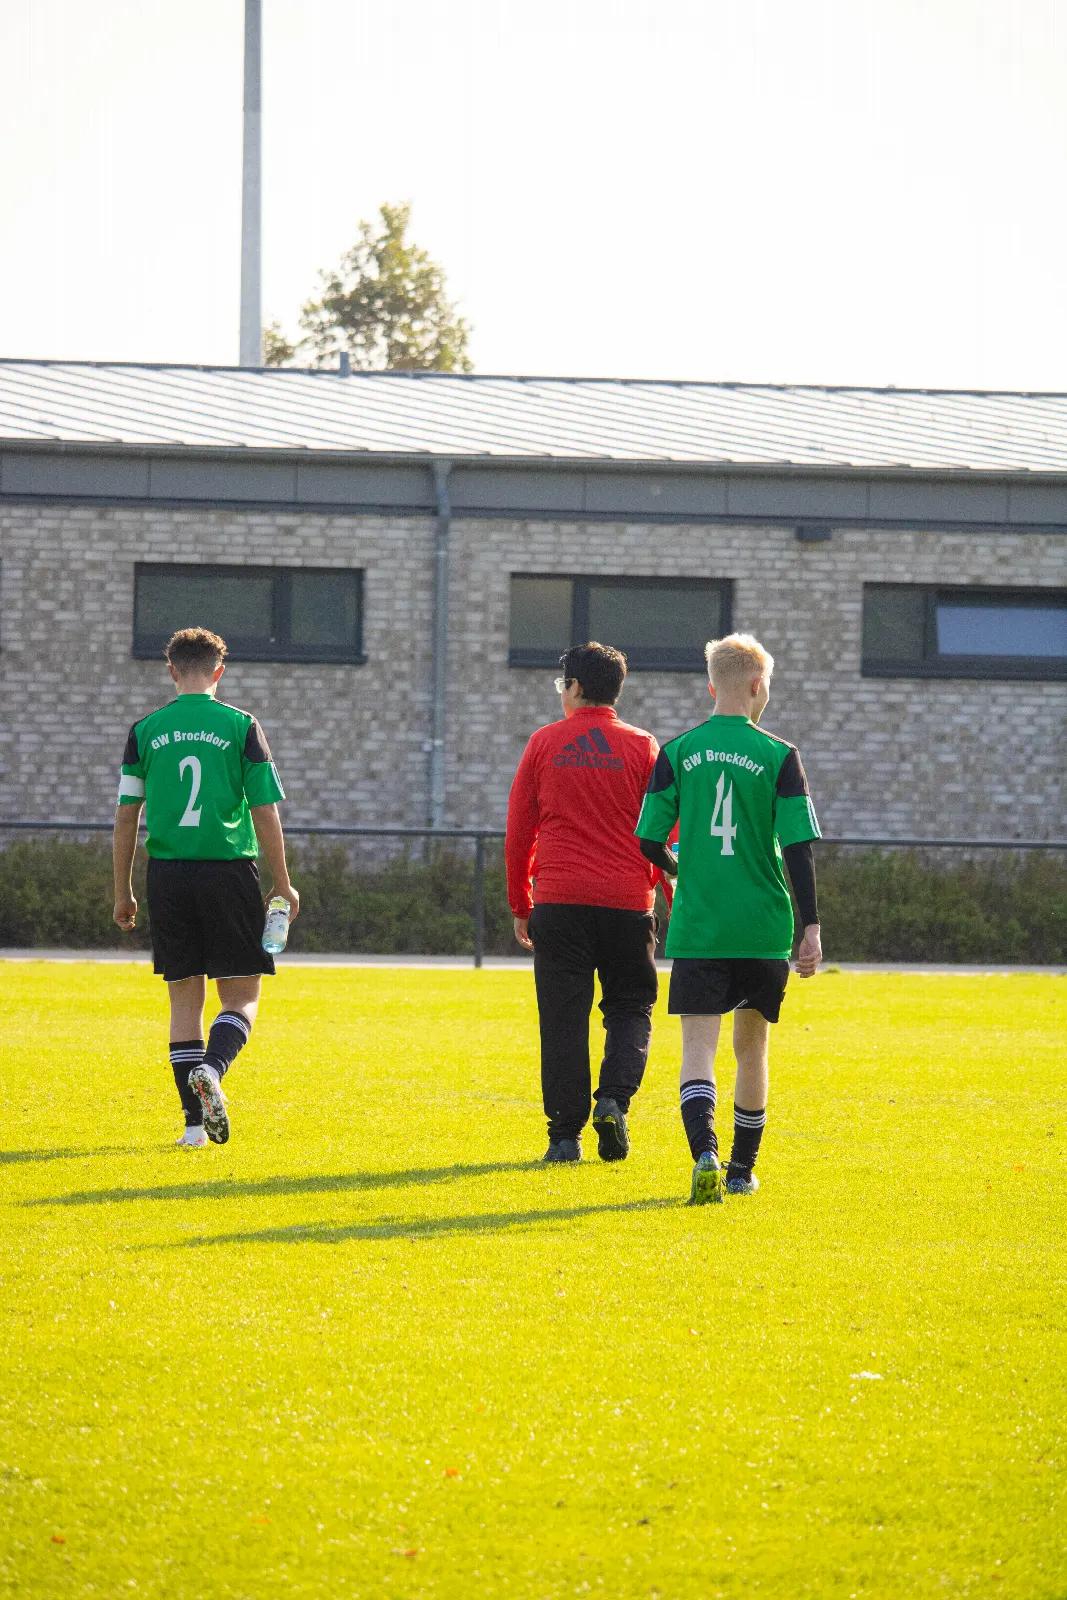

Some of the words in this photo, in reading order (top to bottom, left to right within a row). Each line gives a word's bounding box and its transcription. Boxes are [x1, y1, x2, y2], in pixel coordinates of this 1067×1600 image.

[151, 733, 170, 750] GW
[173, 730, 231, 751] Brockdorf
[553, 751, 623, 770] adidas
[682, 751, 702, 772] GW
[705, 749, 765, 776] Brockdorf
[178, 755, 203, 827] 2
[710, 770, 738, 856] 4
